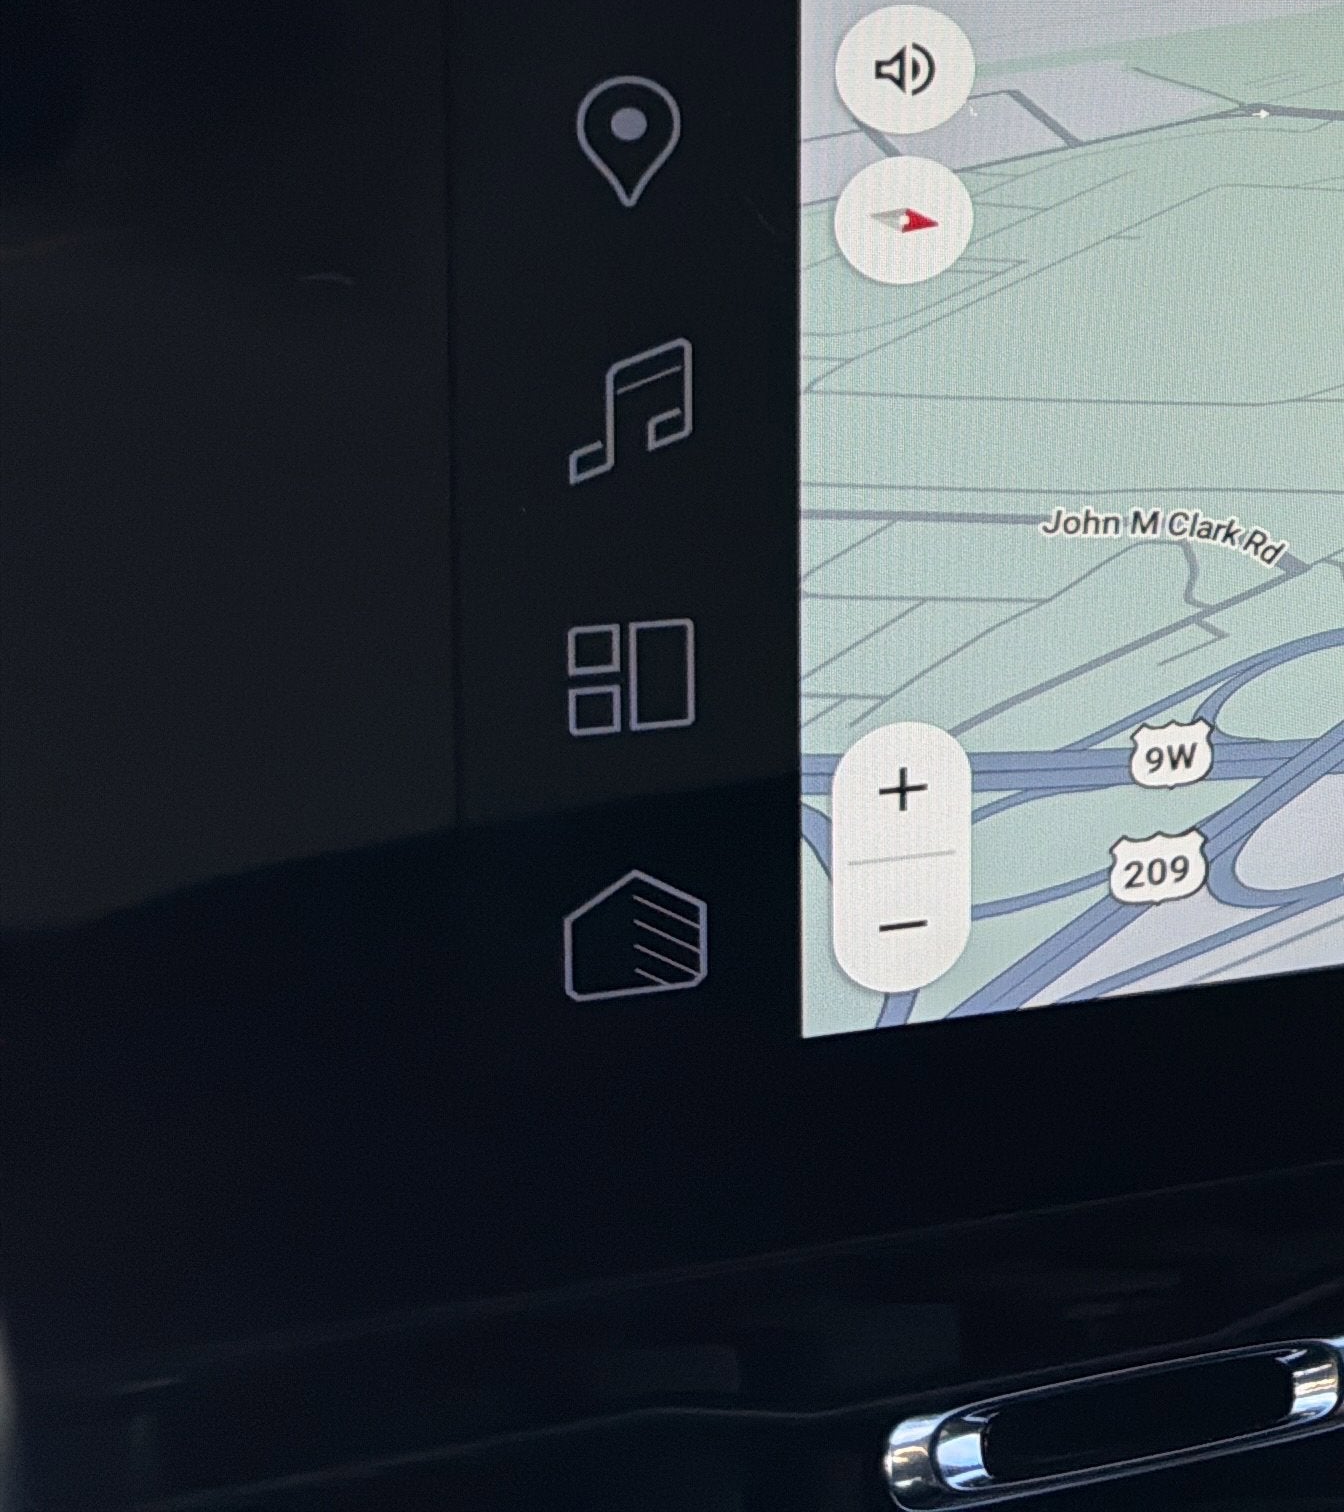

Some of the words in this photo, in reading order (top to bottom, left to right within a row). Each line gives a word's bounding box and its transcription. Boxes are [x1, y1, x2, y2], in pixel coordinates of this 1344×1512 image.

[1042, 510, 1120, 536] John
[1131, 511, 1160, 534] M
[1169, 512, 1242, 545] Clark
[1244, 531, 1285, 564] Rd
[1145, 742, 1197, 774] 9W
[1124, 855, 1189, 889] 209
